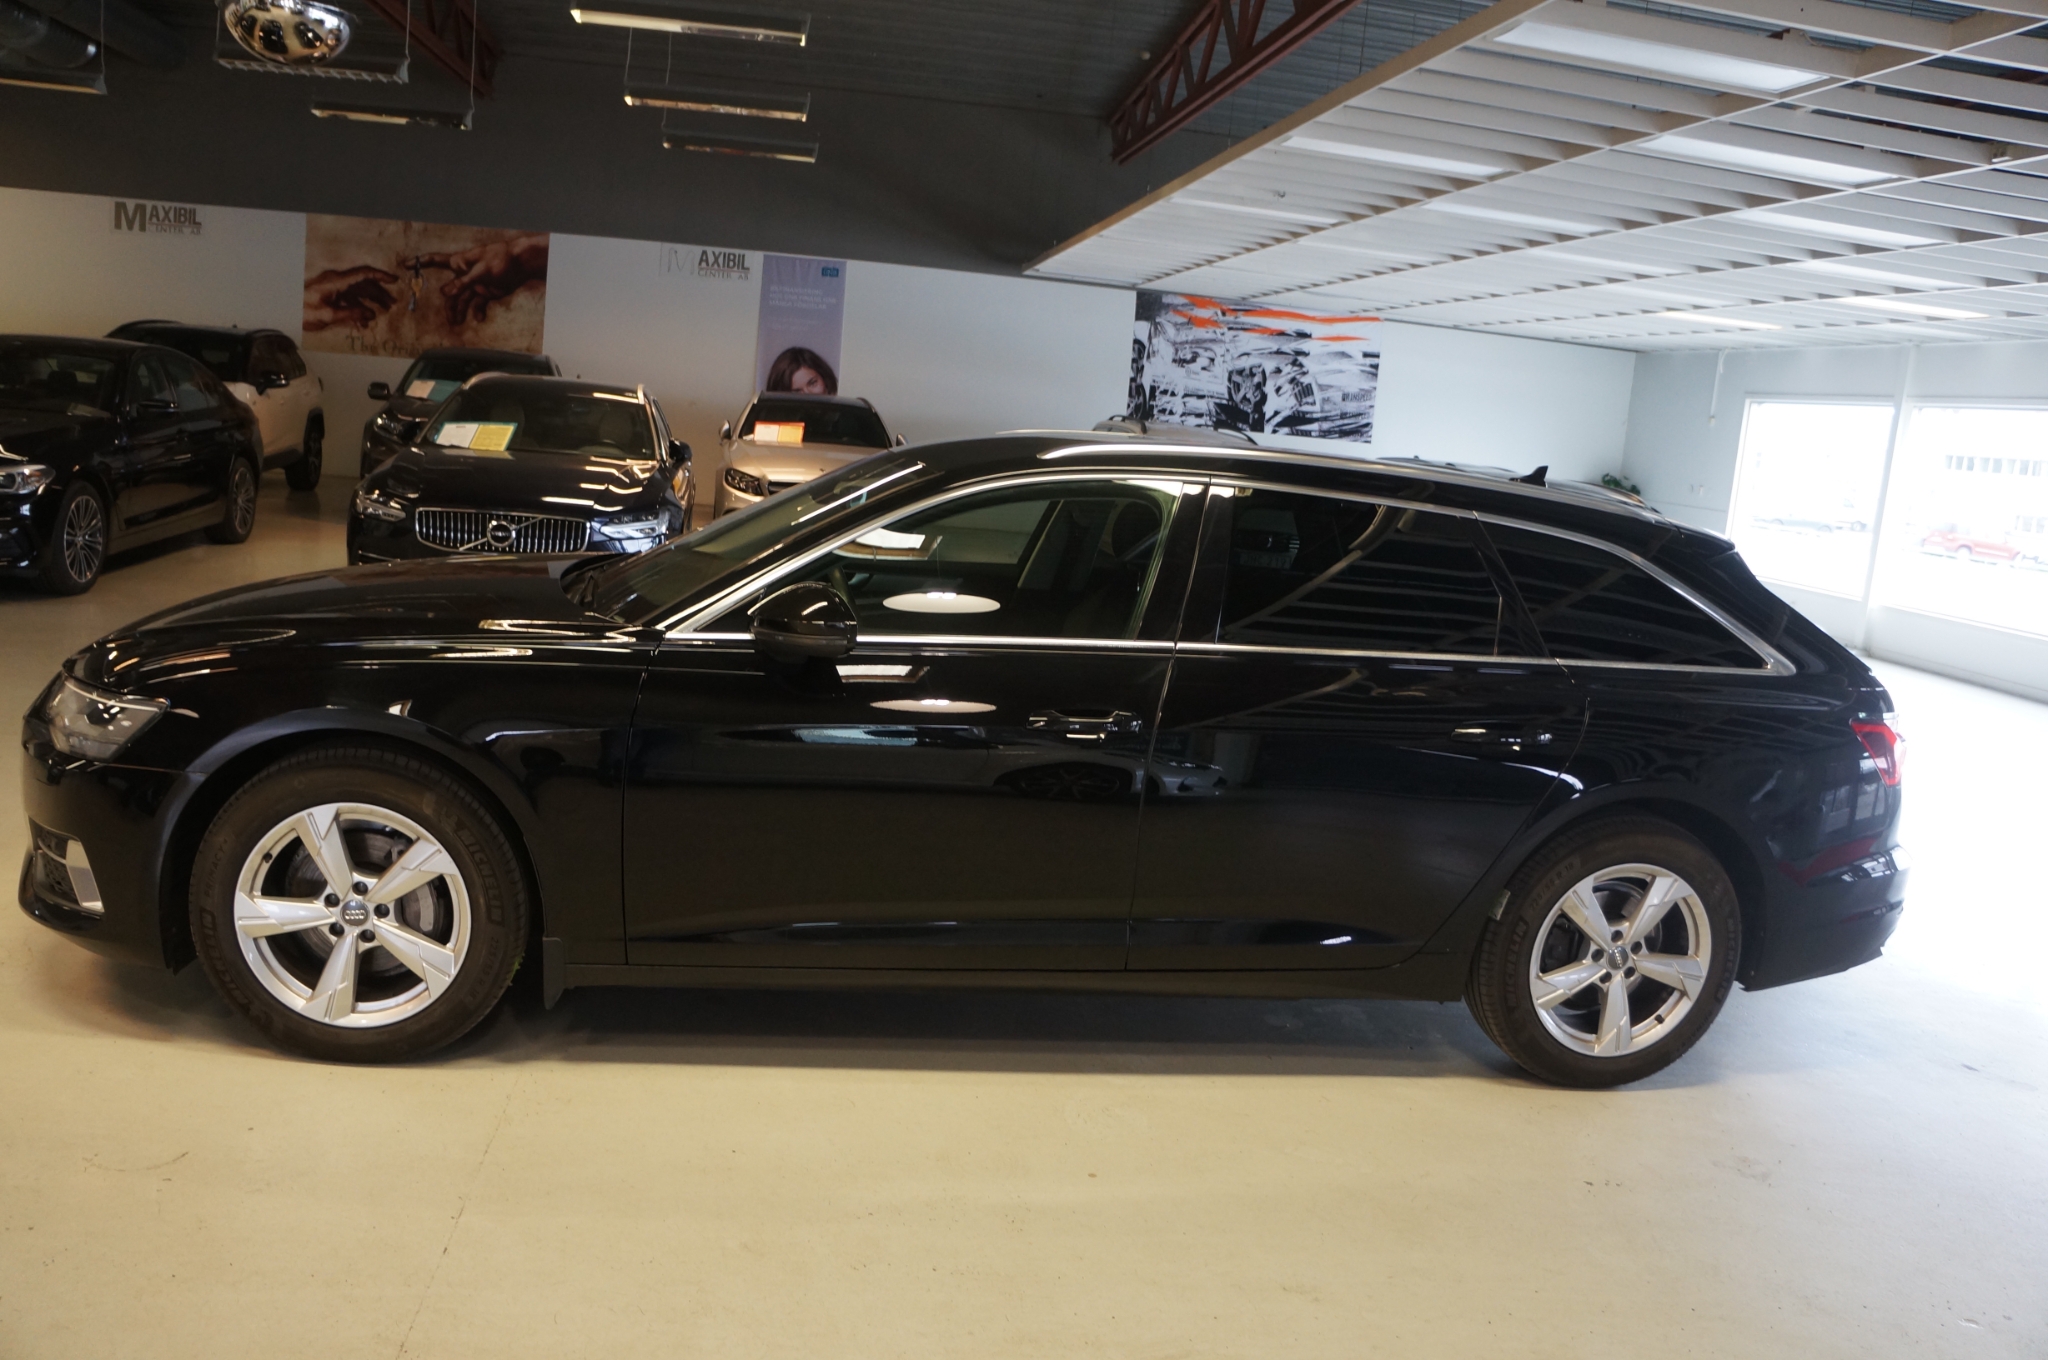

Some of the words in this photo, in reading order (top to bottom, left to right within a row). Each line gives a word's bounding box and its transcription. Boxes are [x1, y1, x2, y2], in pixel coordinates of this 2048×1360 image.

[114, 201, 202, 233] MAXIBIL
[204, 843, 225, 897] PRIMACY
[457, 828, 503, 923] MICHELIN
[201, 911, 249, 1003] MICHELIN
[1505, 921, 1527, 1007] MICHELIN
